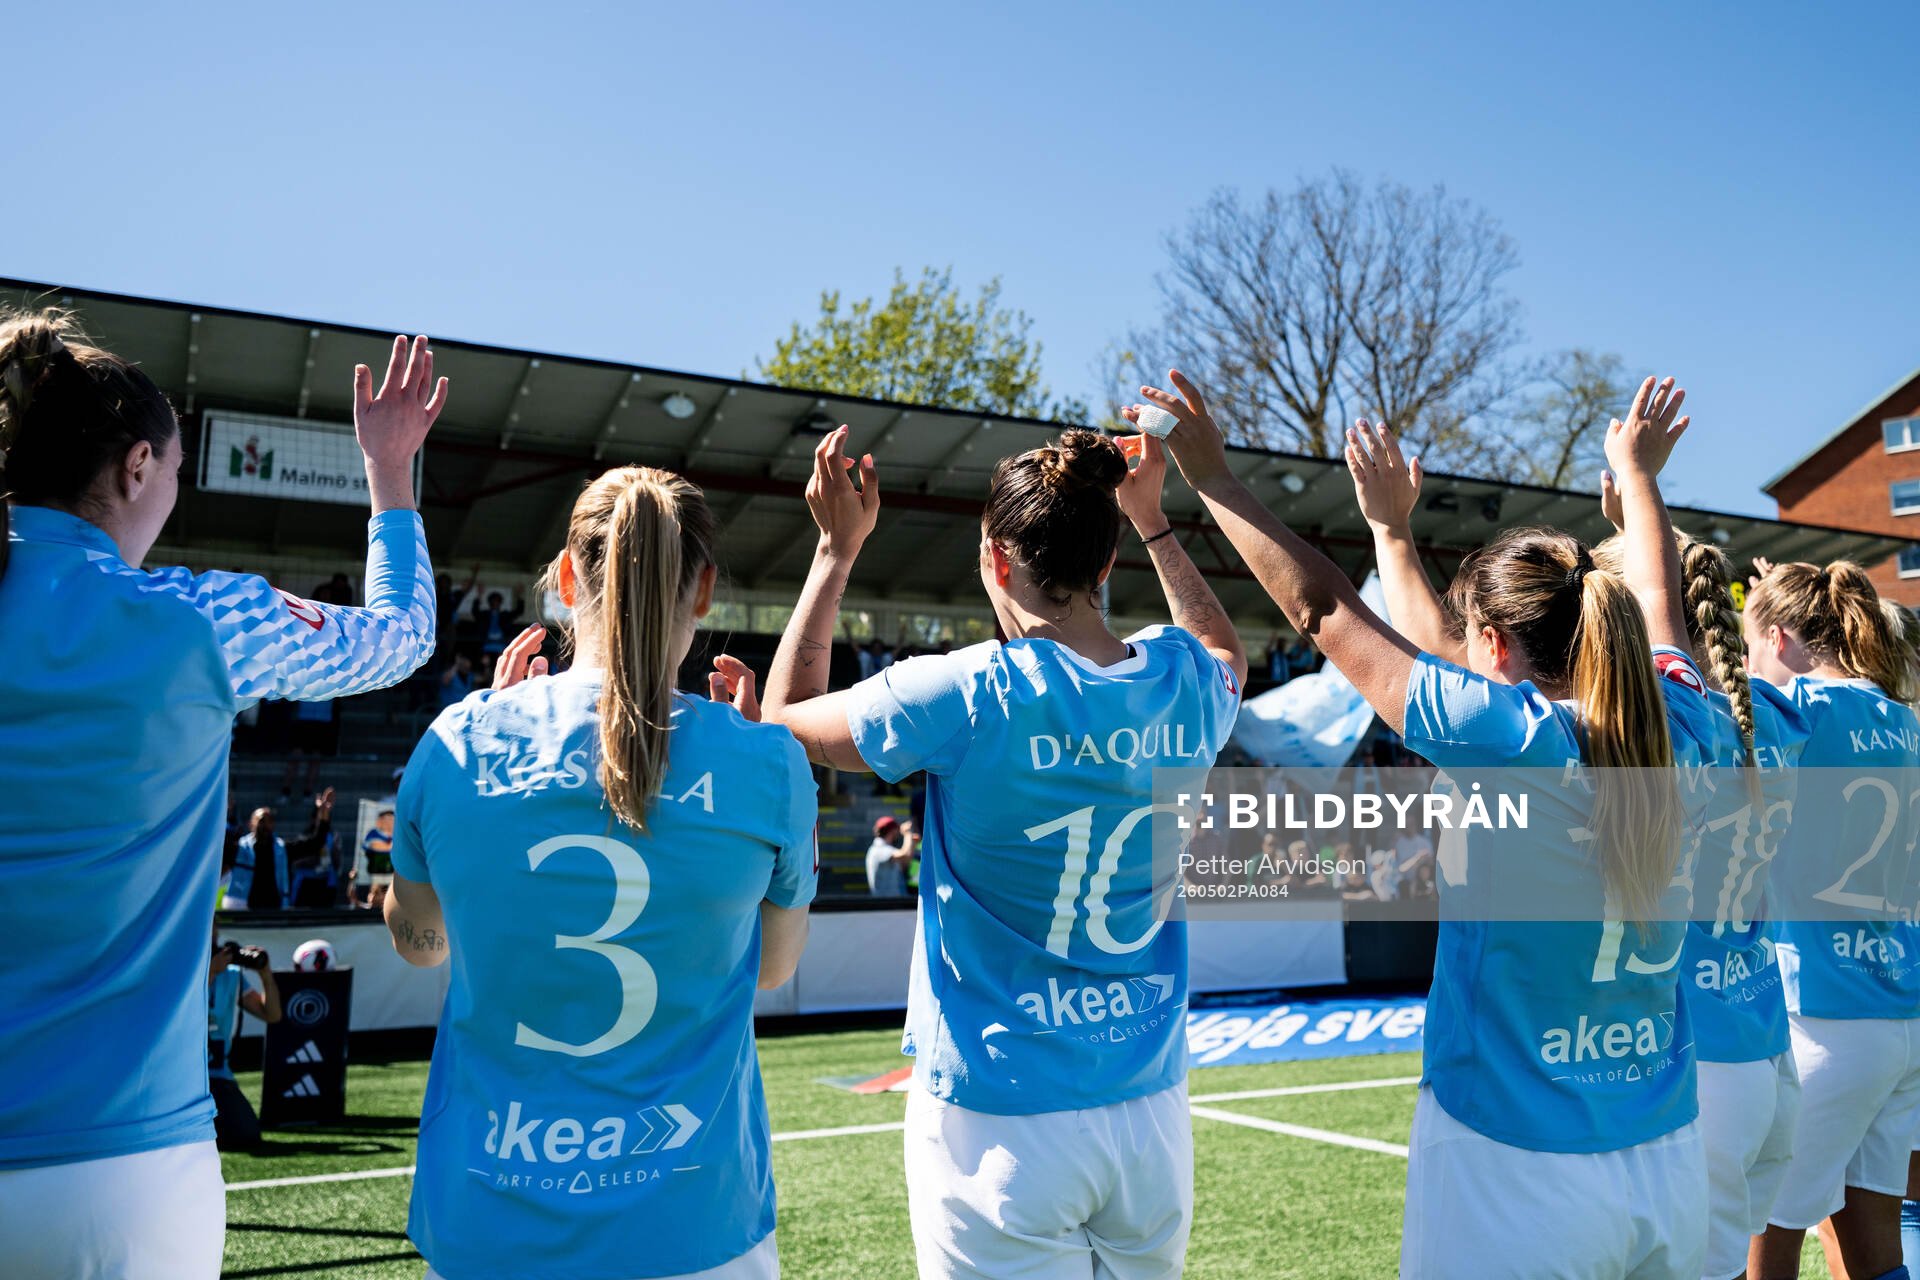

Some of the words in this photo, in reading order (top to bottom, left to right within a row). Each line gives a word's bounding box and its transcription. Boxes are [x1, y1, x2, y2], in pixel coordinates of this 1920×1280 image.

[279, 467, 347, 489] Malmö
[1029, 723, 1209, 770] D'AQUILA
[1849, 727, 1919, 756] KANU
[1813, 776, 1920, 912] 2
[1023, 803, 1195, 960] 10
[515, 834, 658, 1057] 3
[1833, 929, 1890, 964] ake
[1015, 977, 1134, 1027] akea
[1125, 1013, 1168, 1037] ELEDA
[1303, 1005, 1427, 1045] sve
[1540, 1015, 1660, 1065] akea
[1607, 1070, 1622, 1082] OF
[484, 1101, 627, 1164] akea
[496, 1173, 533, 1188] PART
[540, 1178, 566, 1190] OF
[599, 1168, 661, 1188] ELEDA
